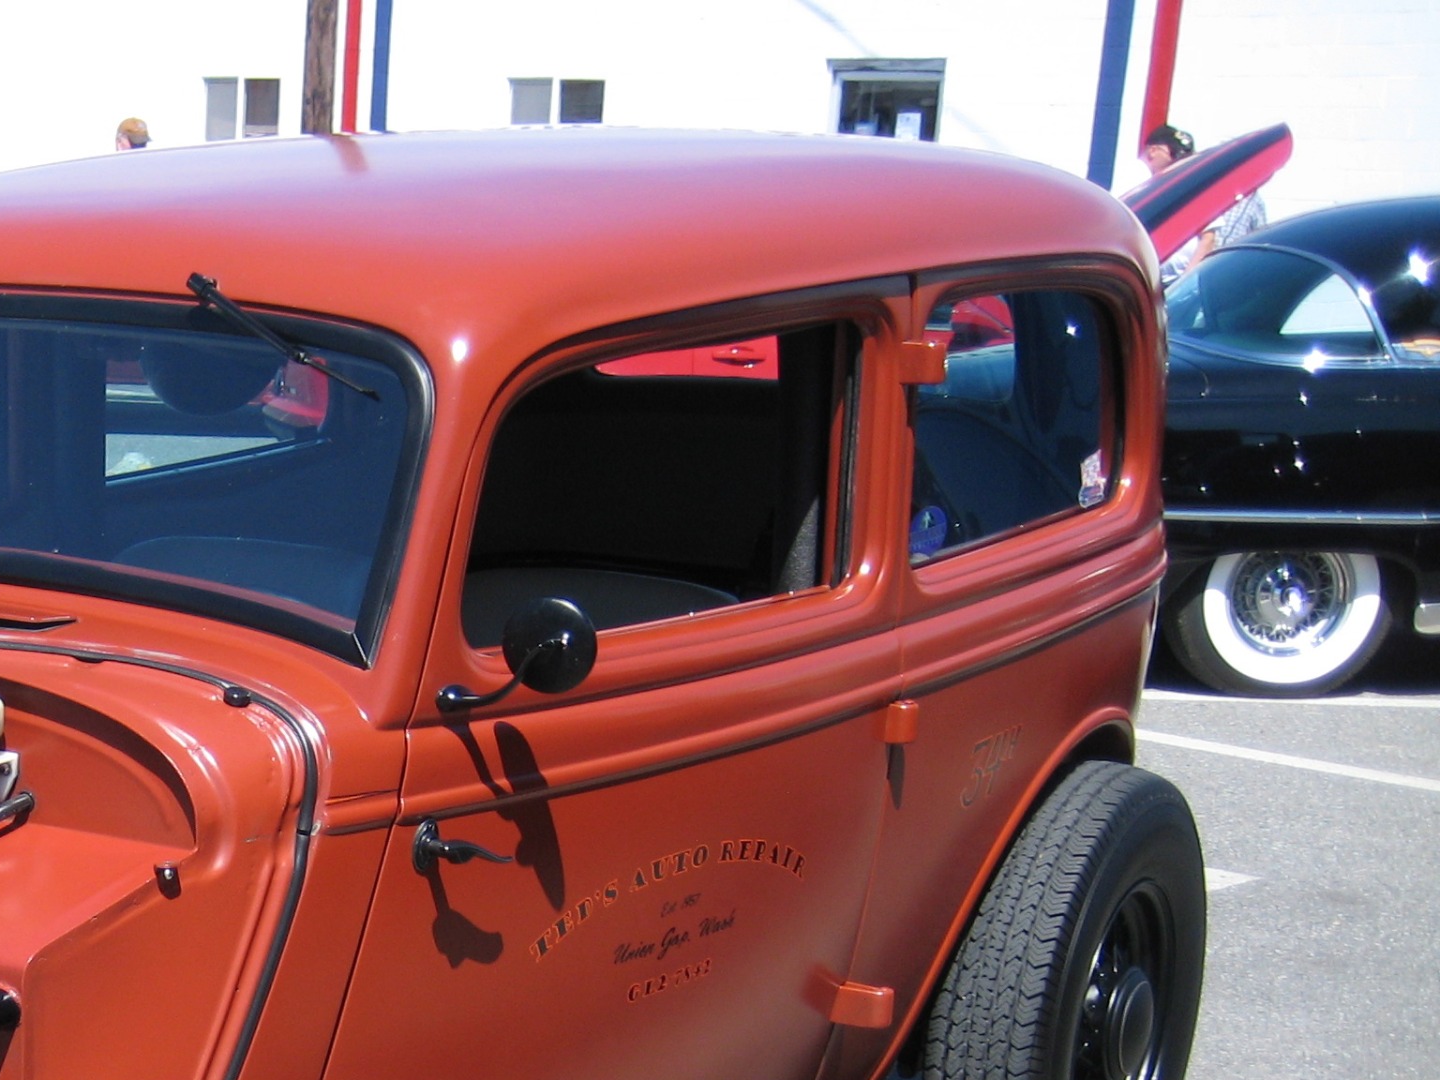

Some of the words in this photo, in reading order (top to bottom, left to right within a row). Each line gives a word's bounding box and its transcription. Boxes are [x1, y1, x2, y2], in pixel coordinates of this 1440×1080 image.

[529, 879, 619, 963] TED'S
[629, 843, 710, 893] AUTO
[717, 839, 807, 882] REPAIR
[613, 941, 655, 965] Union
